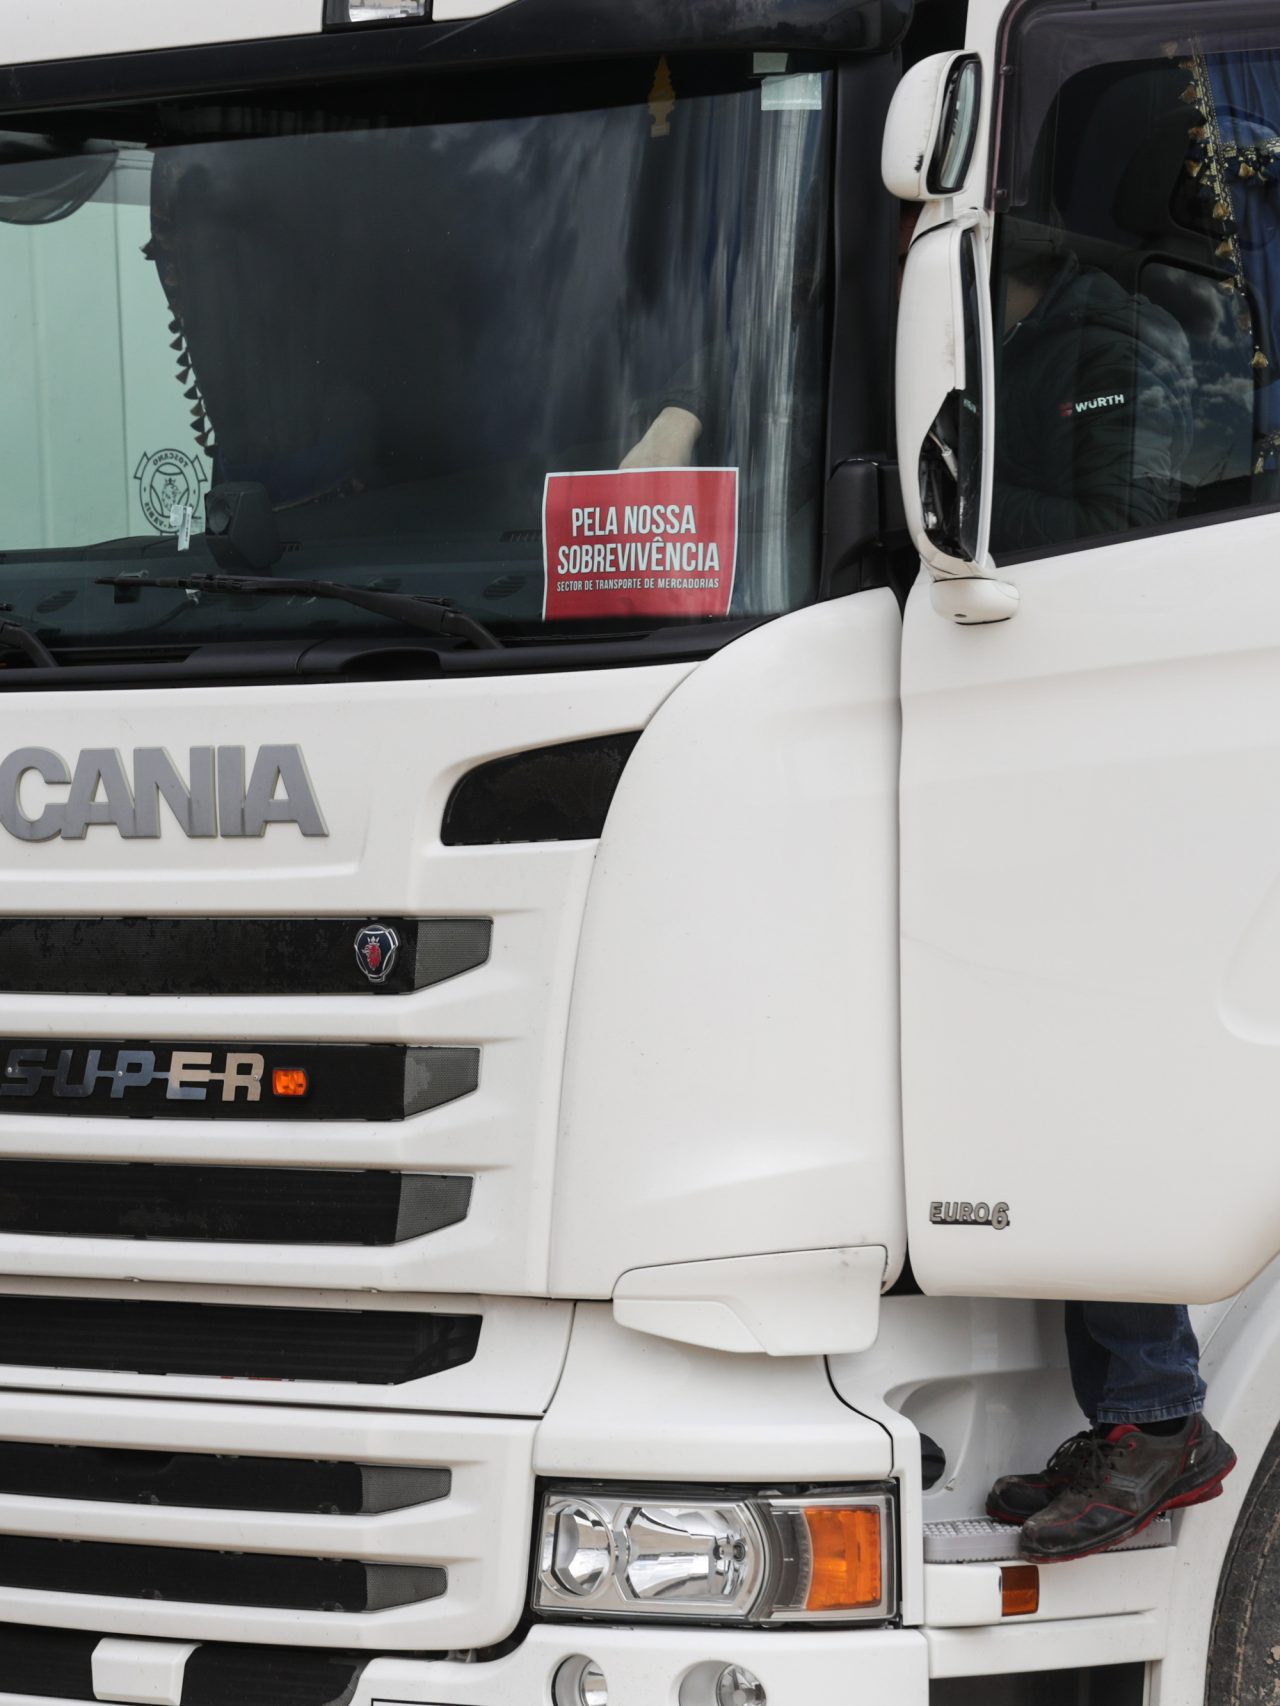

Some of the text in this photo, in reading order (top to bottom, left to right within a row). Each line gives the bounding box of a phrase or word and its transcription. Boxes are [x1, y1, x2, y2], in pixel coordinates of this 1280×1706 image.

[572, 504, 696, 537] PELA NOSSA
[557, 536, 720, 575] SOBREVIVÊNCIA
[556, 577, 719, 592] SECTOR DE TRANSPORTE DE MERCADORIAS
[0, 1048, 265, 1102] SUPER
